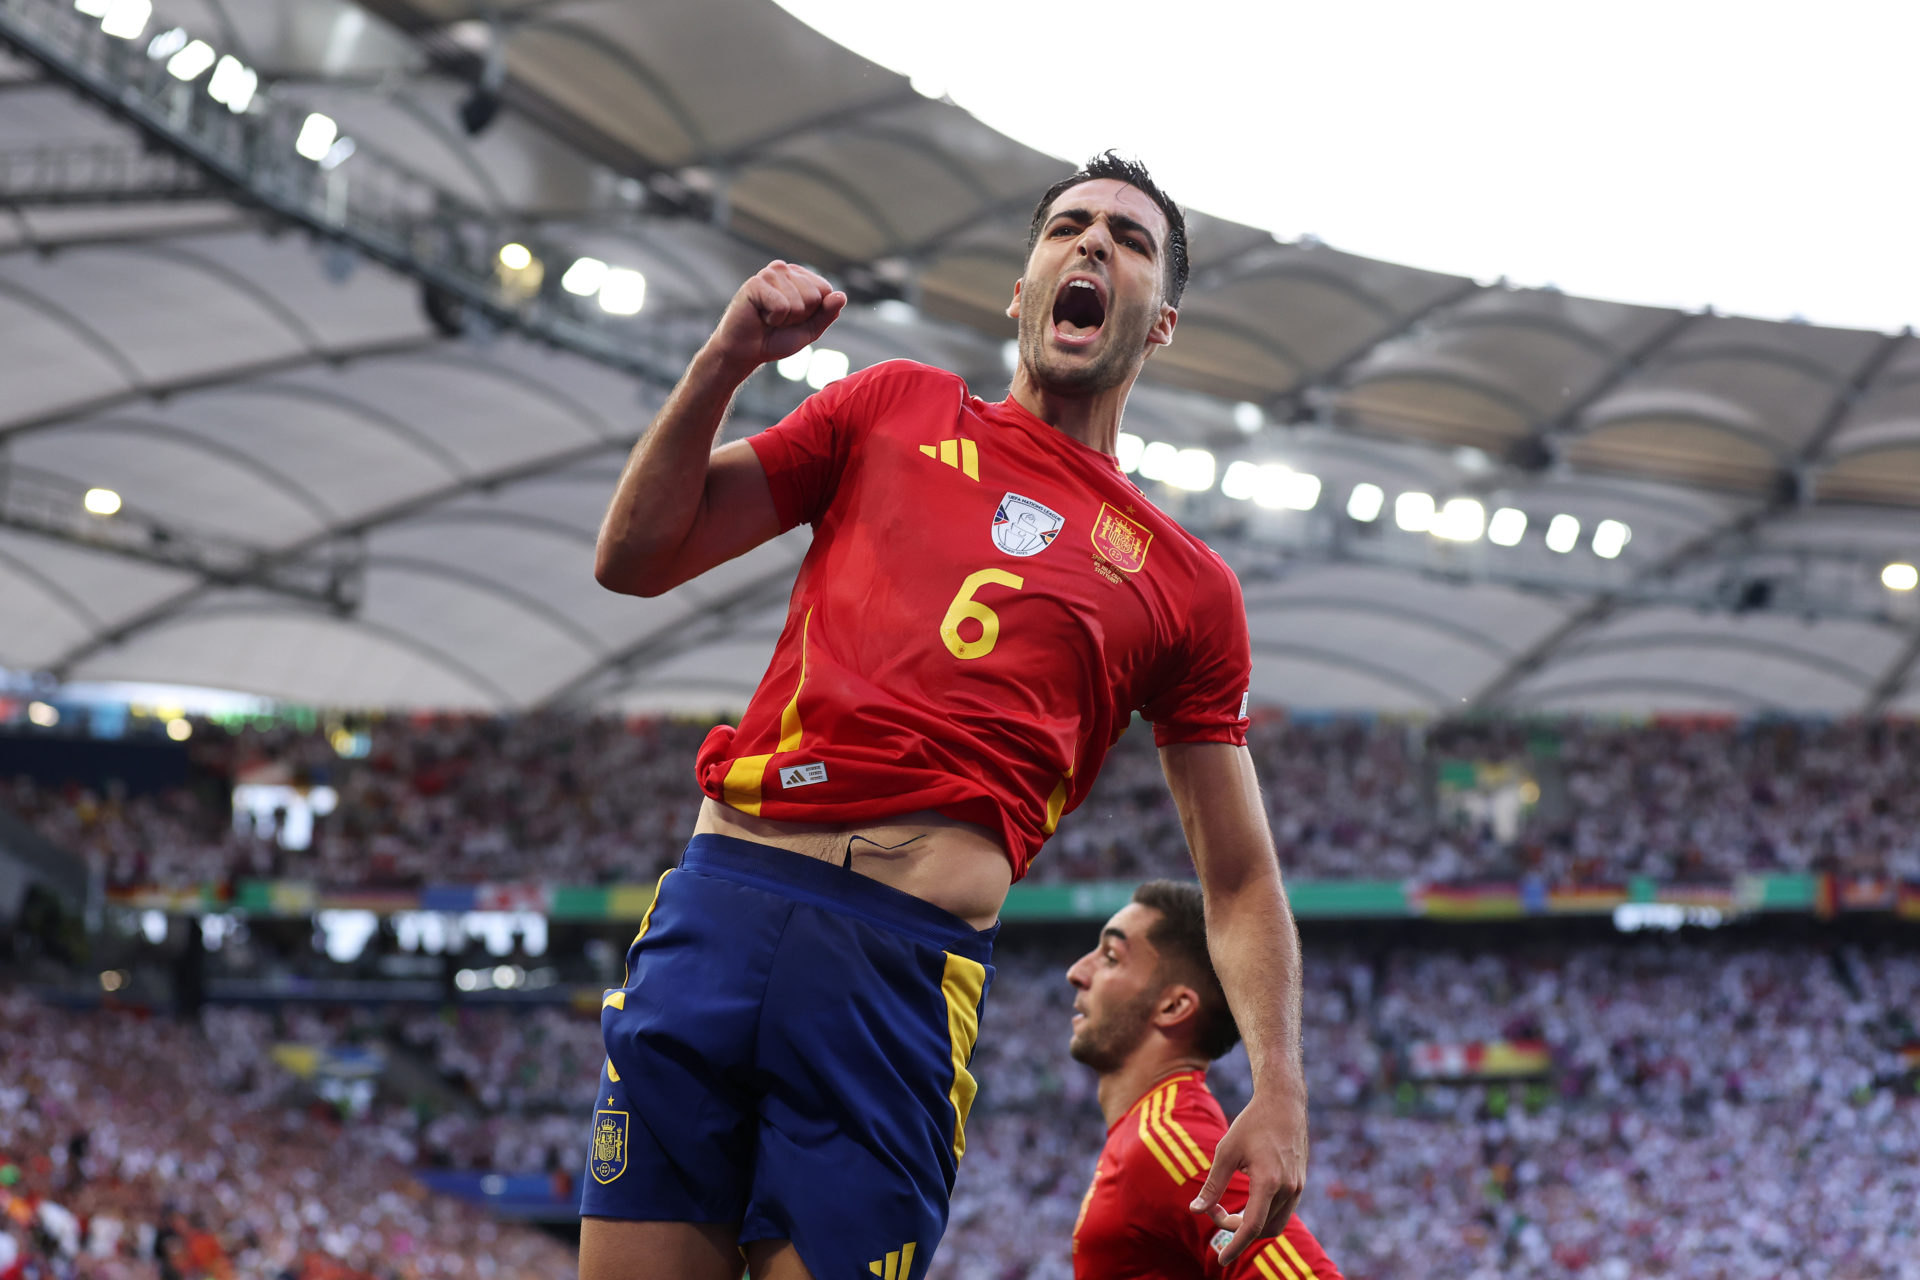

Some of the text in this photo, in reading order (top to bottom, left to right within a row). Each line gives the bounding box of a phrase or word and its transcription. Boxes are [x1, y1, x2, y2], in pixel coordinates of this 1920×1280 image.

[1022, 499, 1043, 511] NATIONS
[1043, 507, 1062, 521] LEAGUE
[940, 568, 1024, 660] 6
